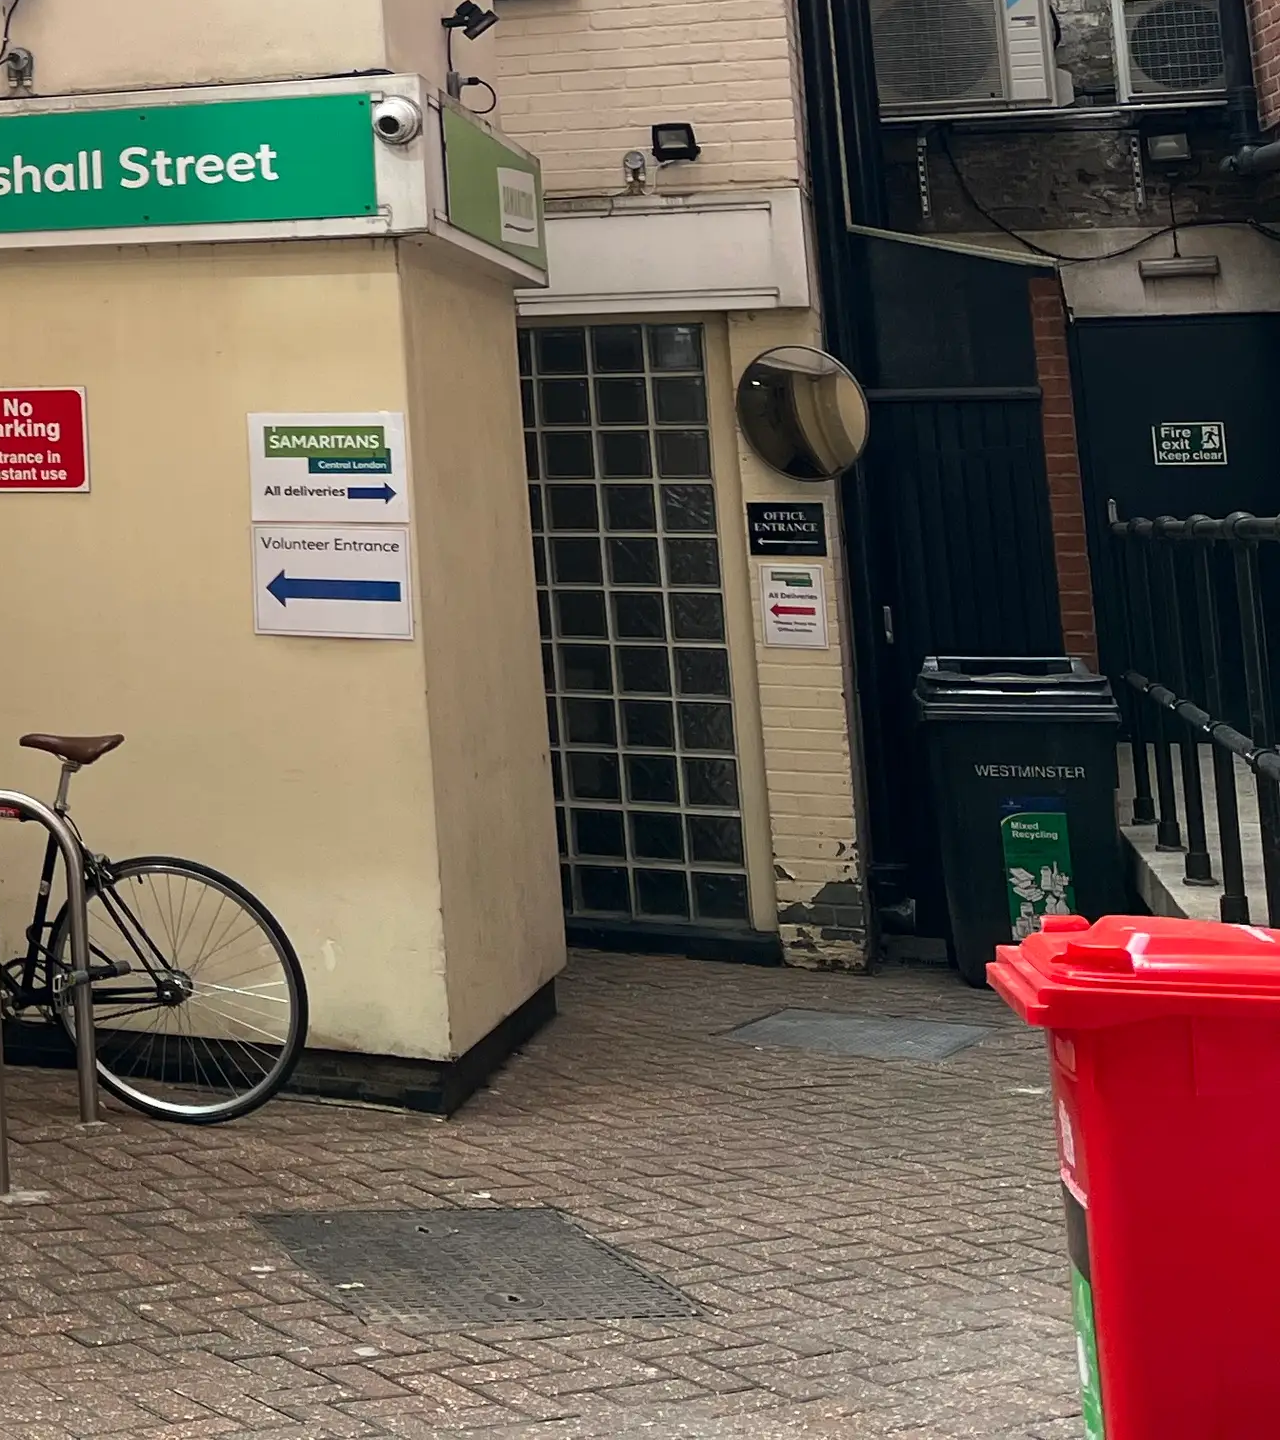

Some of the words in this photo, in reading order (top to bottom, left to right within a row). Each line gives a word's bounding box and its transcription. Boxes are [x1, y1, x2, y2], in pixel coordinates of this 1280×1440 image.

[119, 140, 279, 191] Street
[3, 398, 33, 416] No
[1160, 426, 1192, 438] Fire
[269, 434, 380, 449] SAMARITANS
[1161, 438, 1191, 450] exit
[47, 450, 61, 463] in
[1159, 450, 1190, 463] Keep
[1192, 450, 1223, 460] clear
[317, 460, 351, 469] Central
[353, 461, 387, 469] London
[41, 469, 67, 480] use
[264, 486, 281, 496] All
[284, 486, 346, 497] deliveries
[763, 512, 807, 521] OFFICE
[753, 522, 818, 532] ENTRANCE
[261, 536, 330, 551] Volunteer
[334, 538, 400, 552] Entrance
[974, 764, 1086, 778] WESTMINSTER
[1010, 821, 1039, 830] Mixed
[1011, 830, 1059, 841] Recycling
